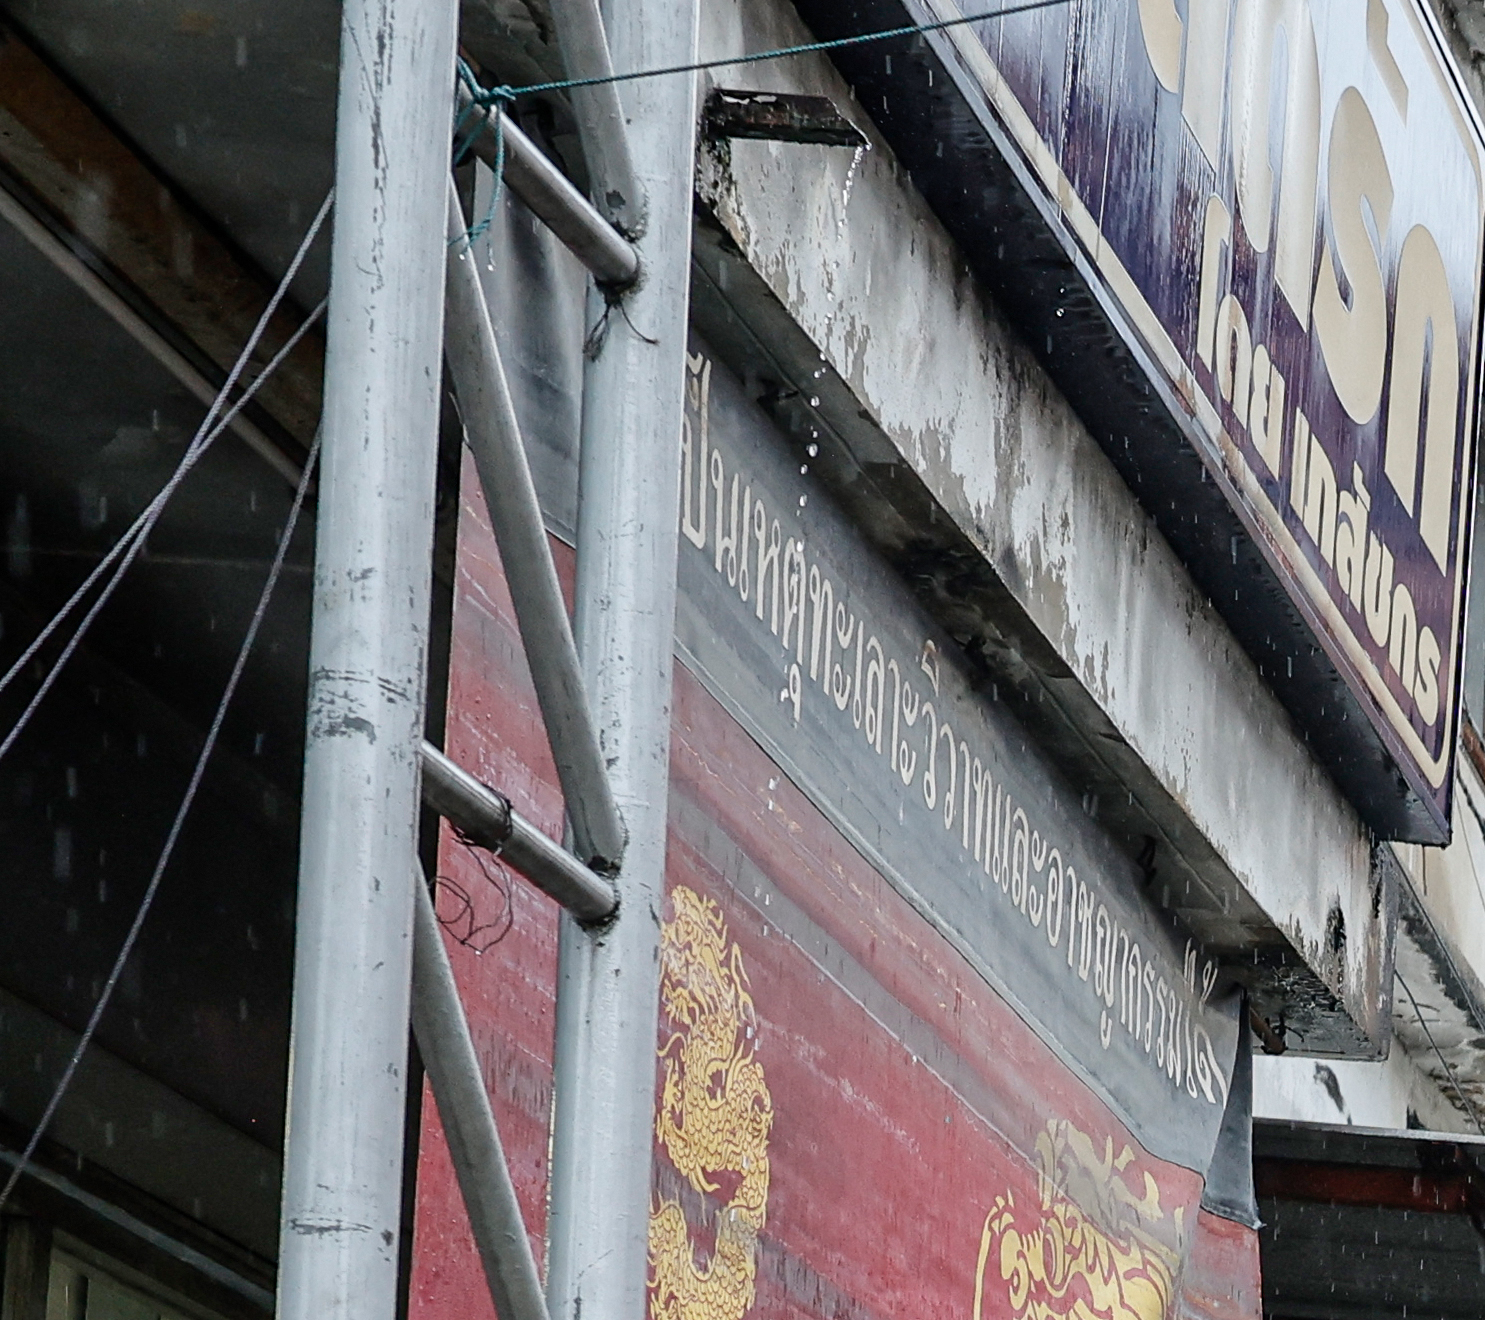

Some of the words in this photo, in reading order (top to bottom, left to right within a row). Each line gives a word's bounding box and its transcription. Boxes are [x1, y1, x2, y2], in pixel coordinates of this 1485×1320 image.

[1198, 193, 1286, 482] โดย
[682, 351, 1228, 1105] ป็นเหตุทะเลาะวิวาทและอาชญากรรมได้
